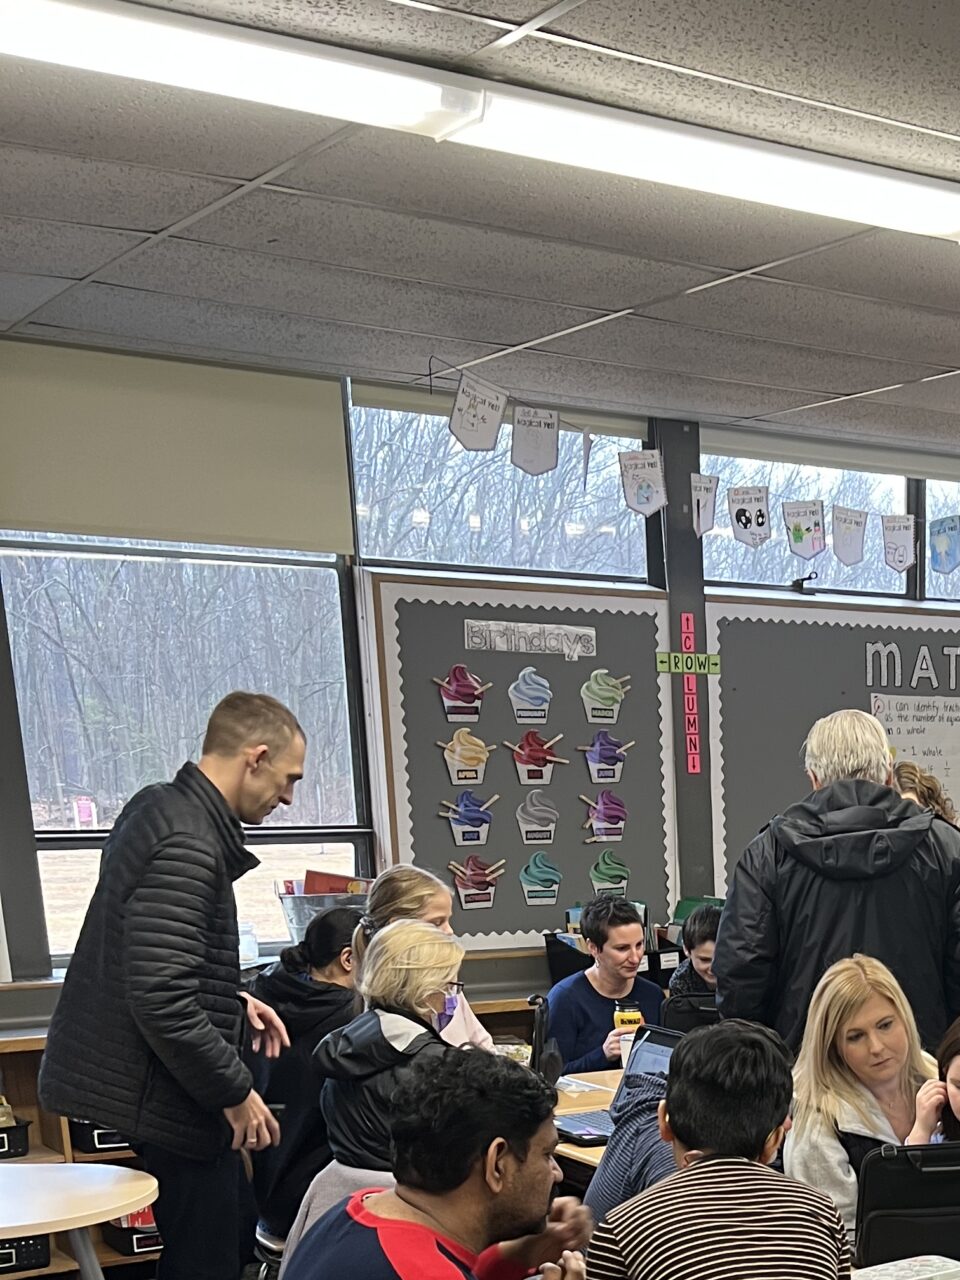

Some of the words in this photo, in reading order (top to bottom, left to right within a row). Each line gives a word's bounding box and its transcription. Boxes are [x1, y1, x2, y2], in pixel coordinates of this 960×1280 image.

[467, 619, 596, 661] Birthdays
[672, 653, 709, 670] ROW
[914, 700, 940, 717] identify
[897, 713, 909, 722] the
[912, 714, 936, 723] number
[921, 745, 943, 757] whole
